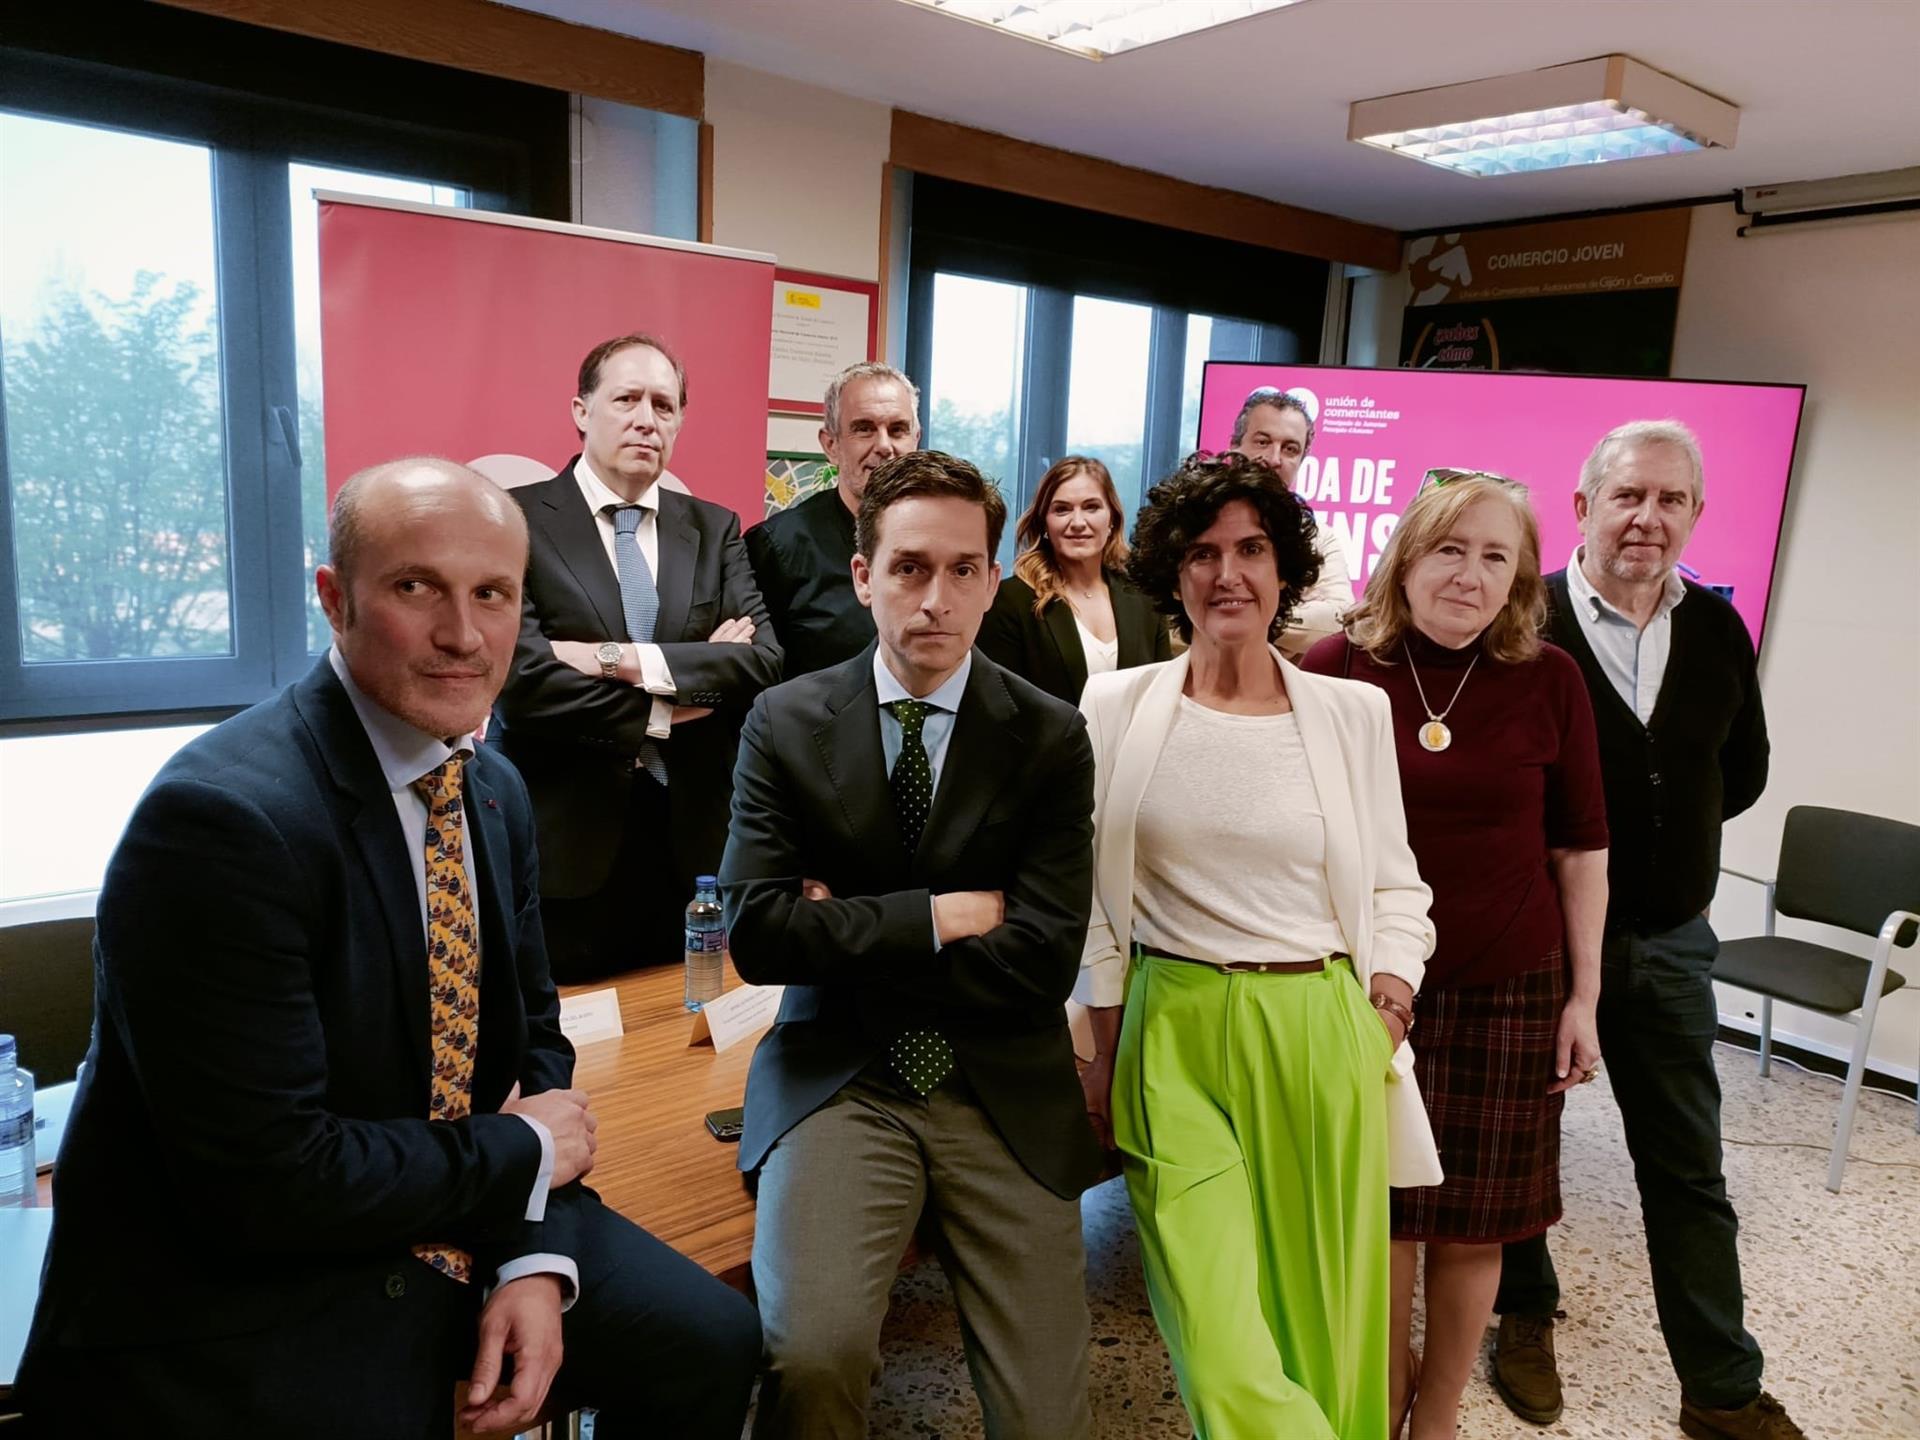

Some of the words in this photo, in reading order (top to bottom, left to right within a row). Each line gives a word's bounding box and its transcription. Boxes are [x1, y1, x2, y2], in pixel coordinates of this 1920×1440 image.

[1487, 248, 1568, 271] COMERCIO
[1572, 243, 1625, 263] JOVEN
[1600, 275, 1625, 291] Gijón
[1634, 271, 1674, 286] Carreño
[1325, 395, 1357, 407] unión
[1361, 396, 1376, 408] de
[1323, 408, 1400, 420] comerciantes
[1349, 457, 1396, 505] DE
